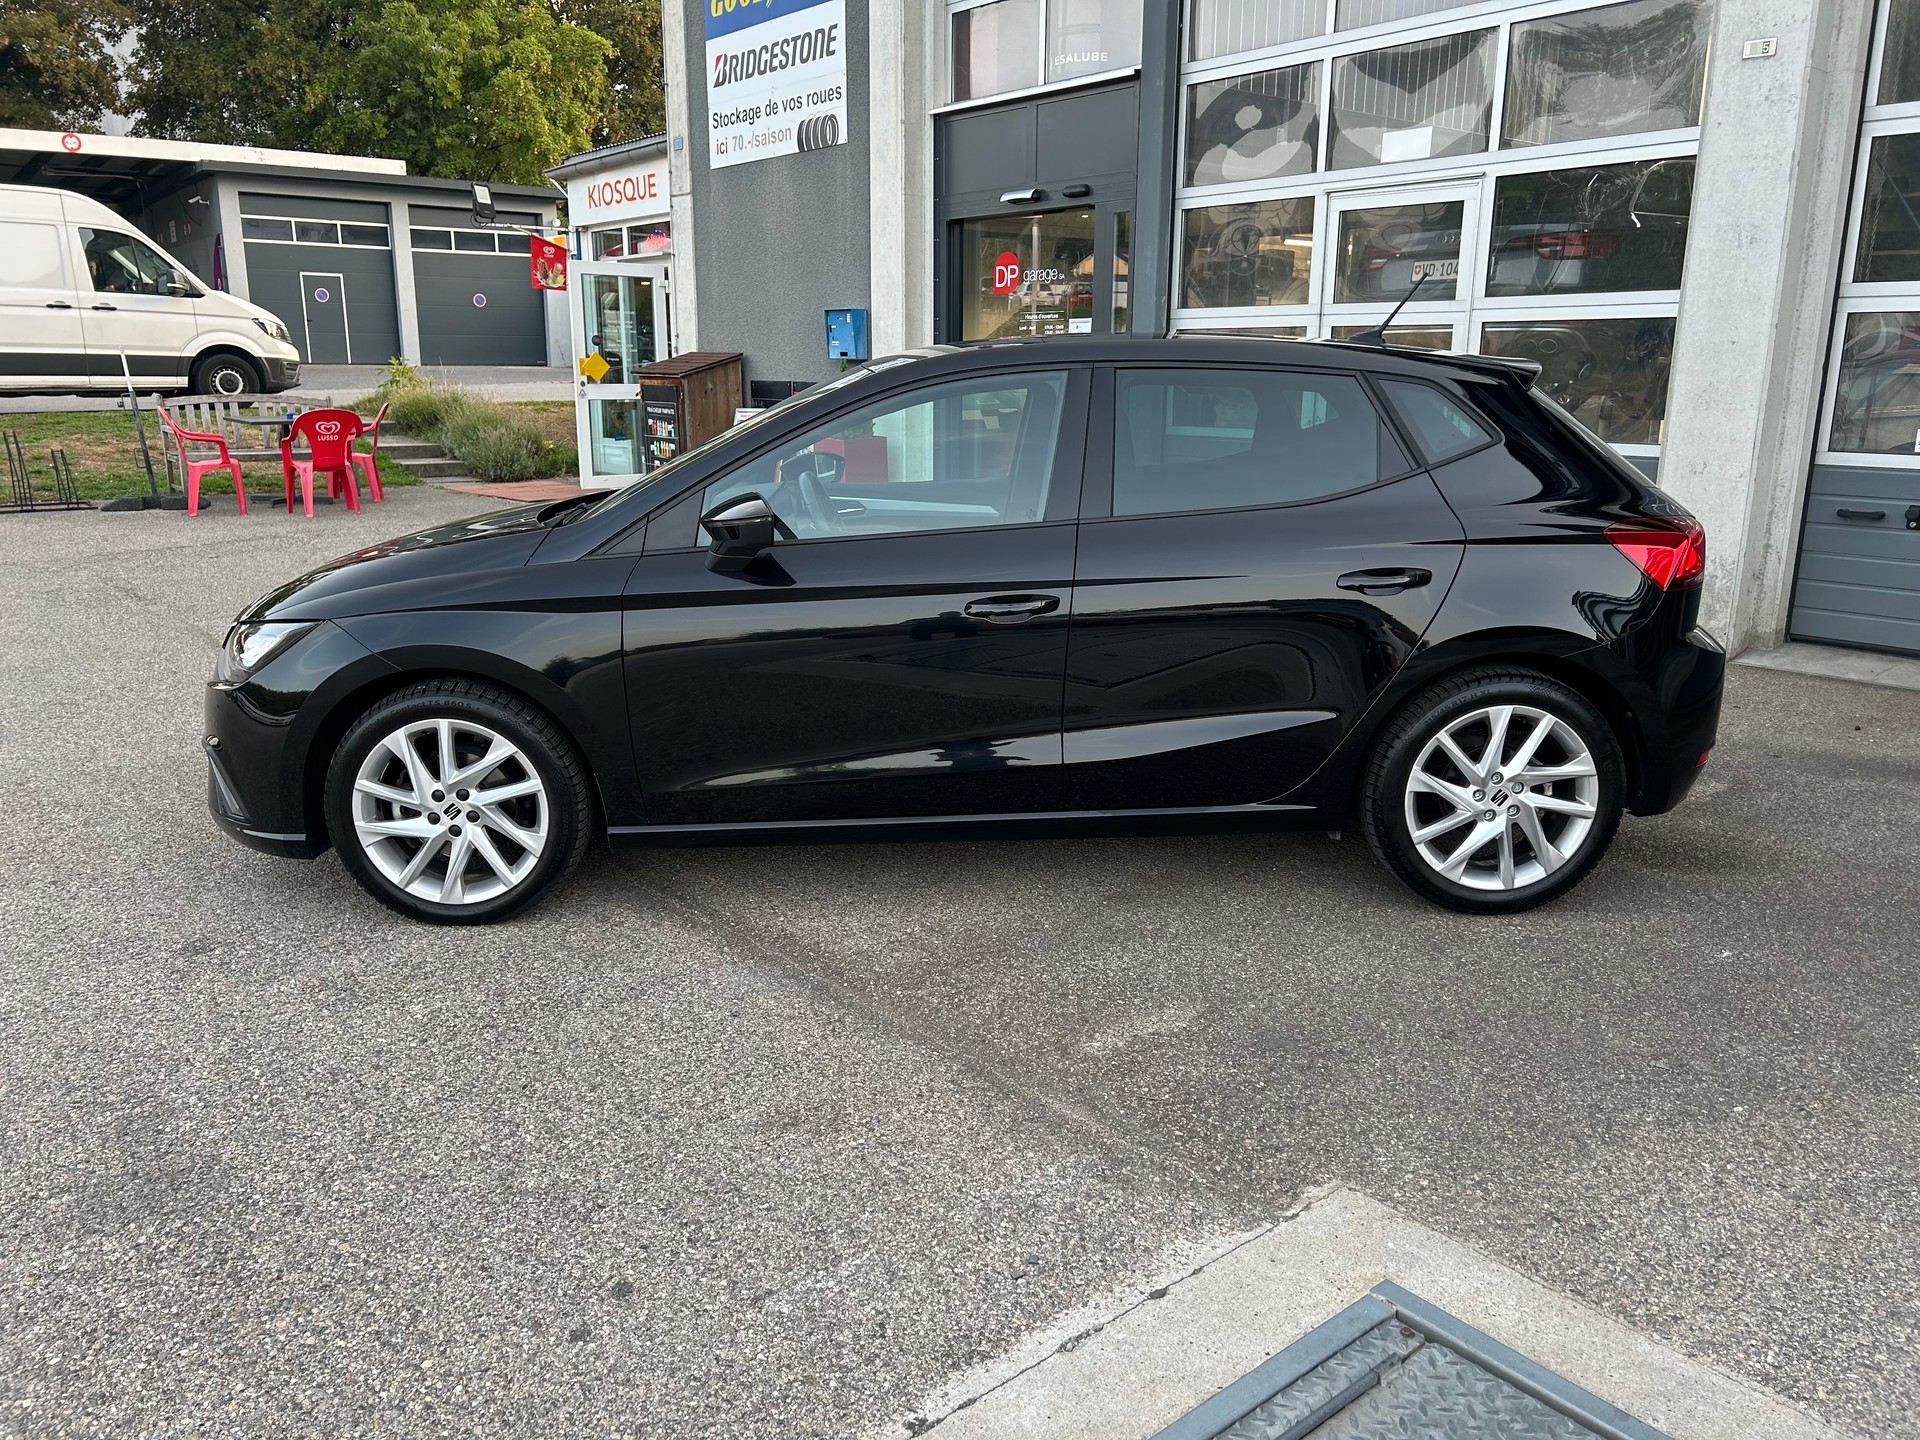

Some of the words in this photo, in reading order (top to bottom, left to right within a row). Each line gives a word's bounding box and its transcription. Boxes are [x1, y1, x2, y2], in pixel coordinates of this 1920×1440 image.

[713, 23, 838, 88] BRIDGESTONE
[1762, 42, 1770, 53] 5
[712, 107, 761, 129] Stockage
[765, 99, 779, 117] de
[781, 95, 803, 113] vos
[806, 85, 842, 107] roues
[716, 137, 728, 155] ici
[587, 173, 657, 209] KIOSQUE
[995, 265, 1019, 288] DP
[1023, 268, 1058, 284] garage
[317, 434, 339, 442] LUSSO
